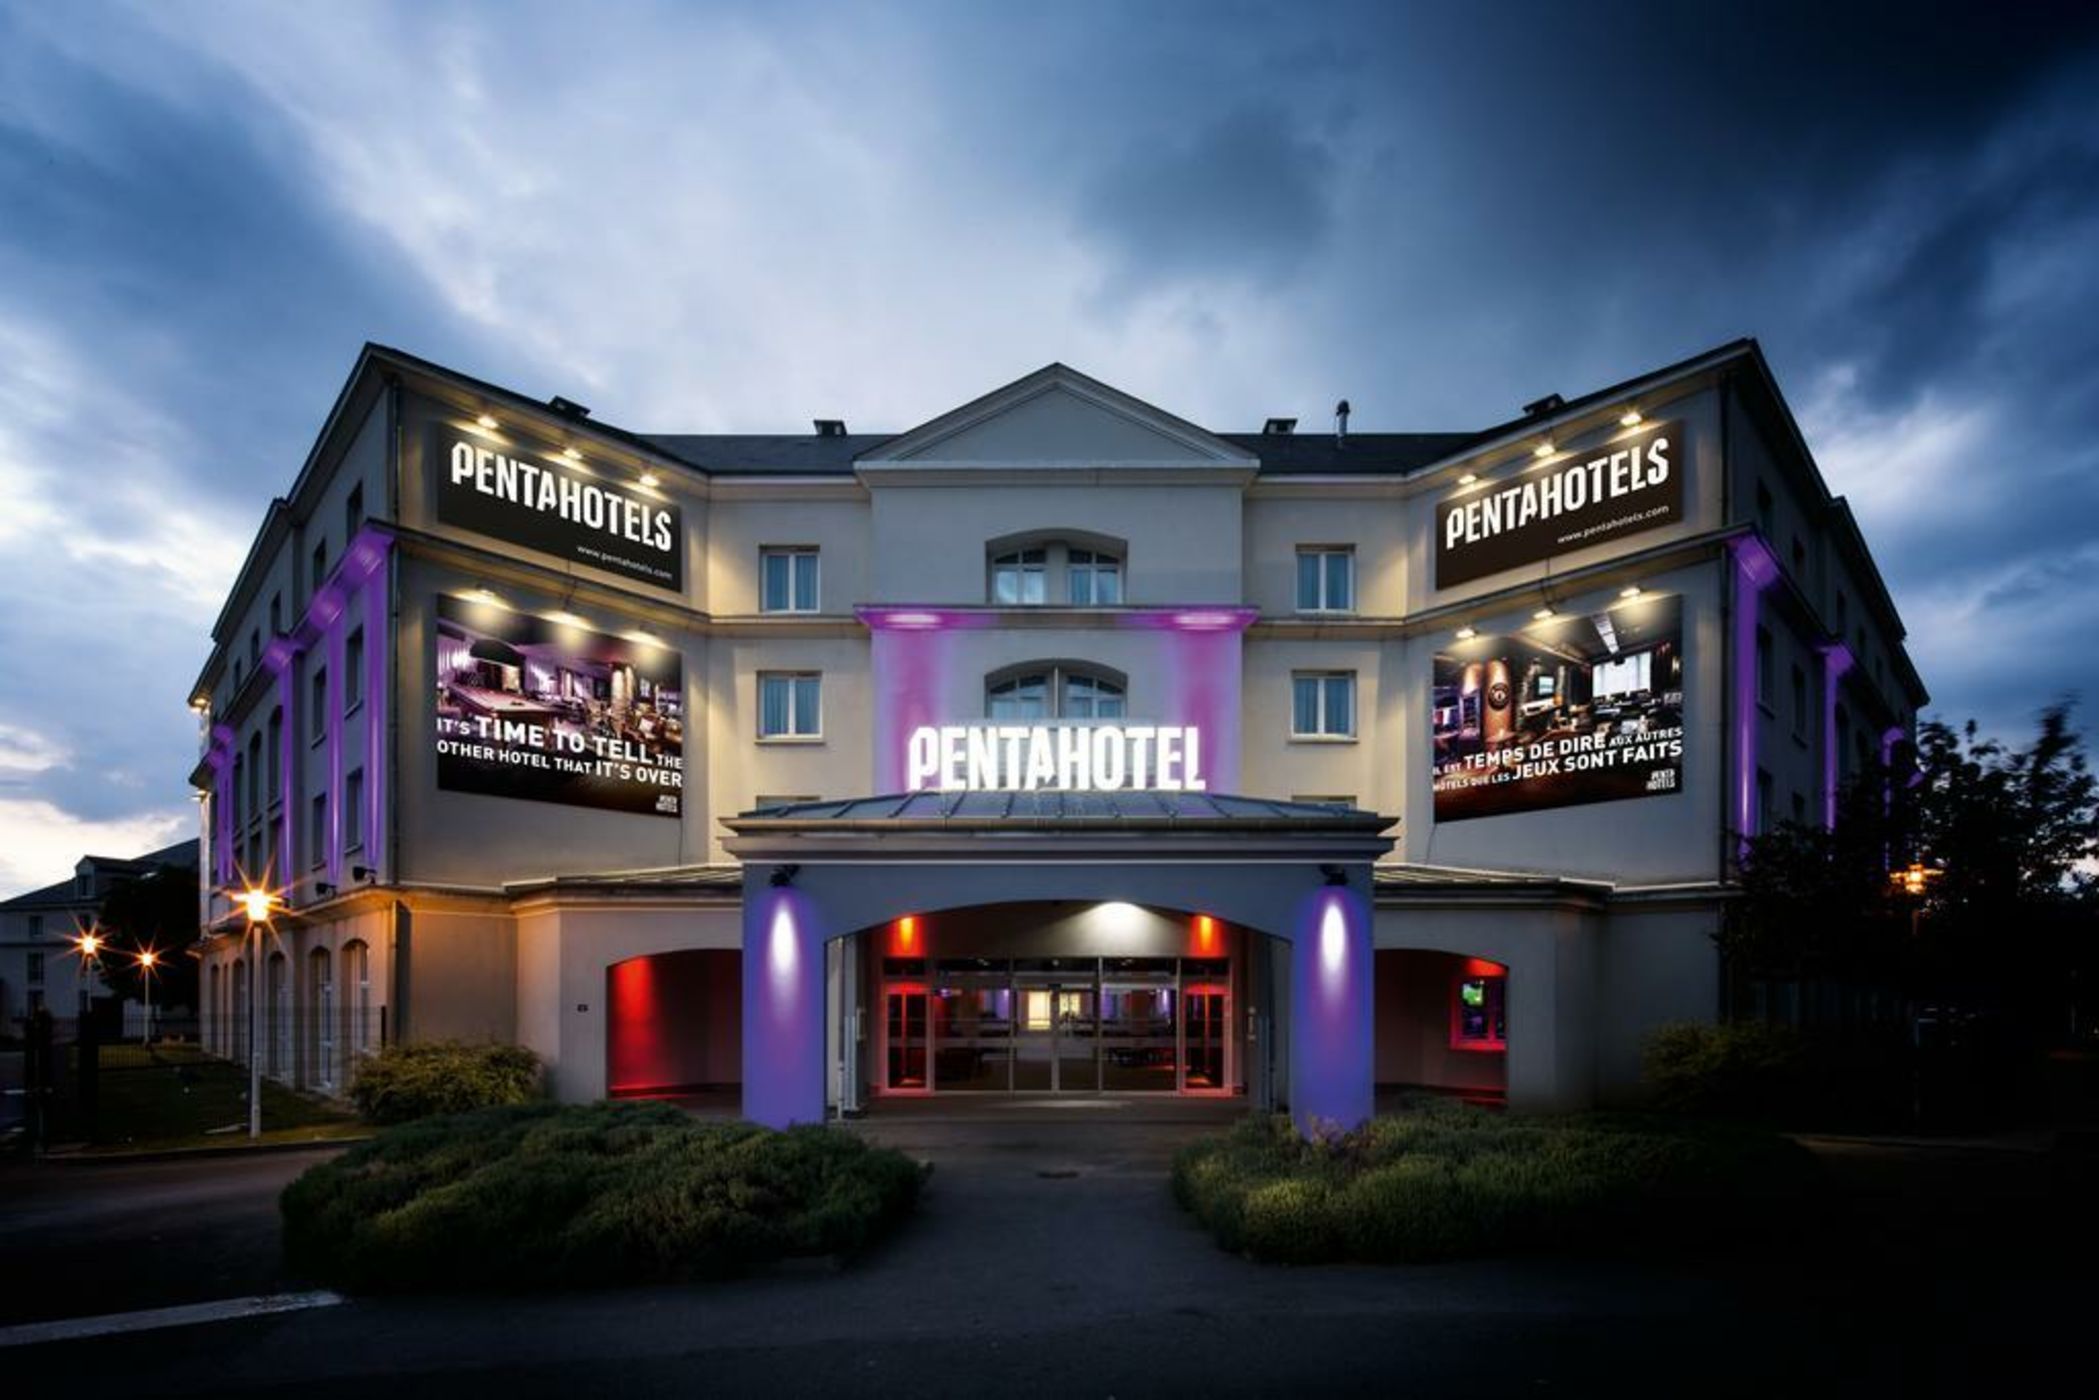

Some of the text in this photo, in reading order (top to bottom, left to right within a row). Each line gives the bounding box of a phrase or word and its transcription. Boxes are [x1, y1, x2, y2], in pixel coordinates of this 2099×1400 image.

[451, 440, 672, 552] PENTAHOTELS
[1446, 438, 1670, 550] PENTAHOTELS
[1557, 504, 1670, 544] www.pentahotels.com
[576, 545, 673, 580] www.pentahotels.com
[436, 715, 683, 770] IT'S TIME TO TELL THE
[436, 739, 683, 787] OTHER HOTEL THAT IT'S OVER
[906, 725, 1206, 791] PENTAHOTEL
[1464, 748, 1524, 771] TEMPS
[1530, 741, 1555, 759] DE
[1560, 733, 1606, 756] DIRE
[1609, 735, 1633, 747] AUX
[1635, 727, 1683, 744] AUTRES
[1491, 773, 1510, 784] LES
[1512, 759, 1560, 780] JEUX
[1565, 750, 1617, 772] SONT
[1622, 740, 1683, 764] FAITS
